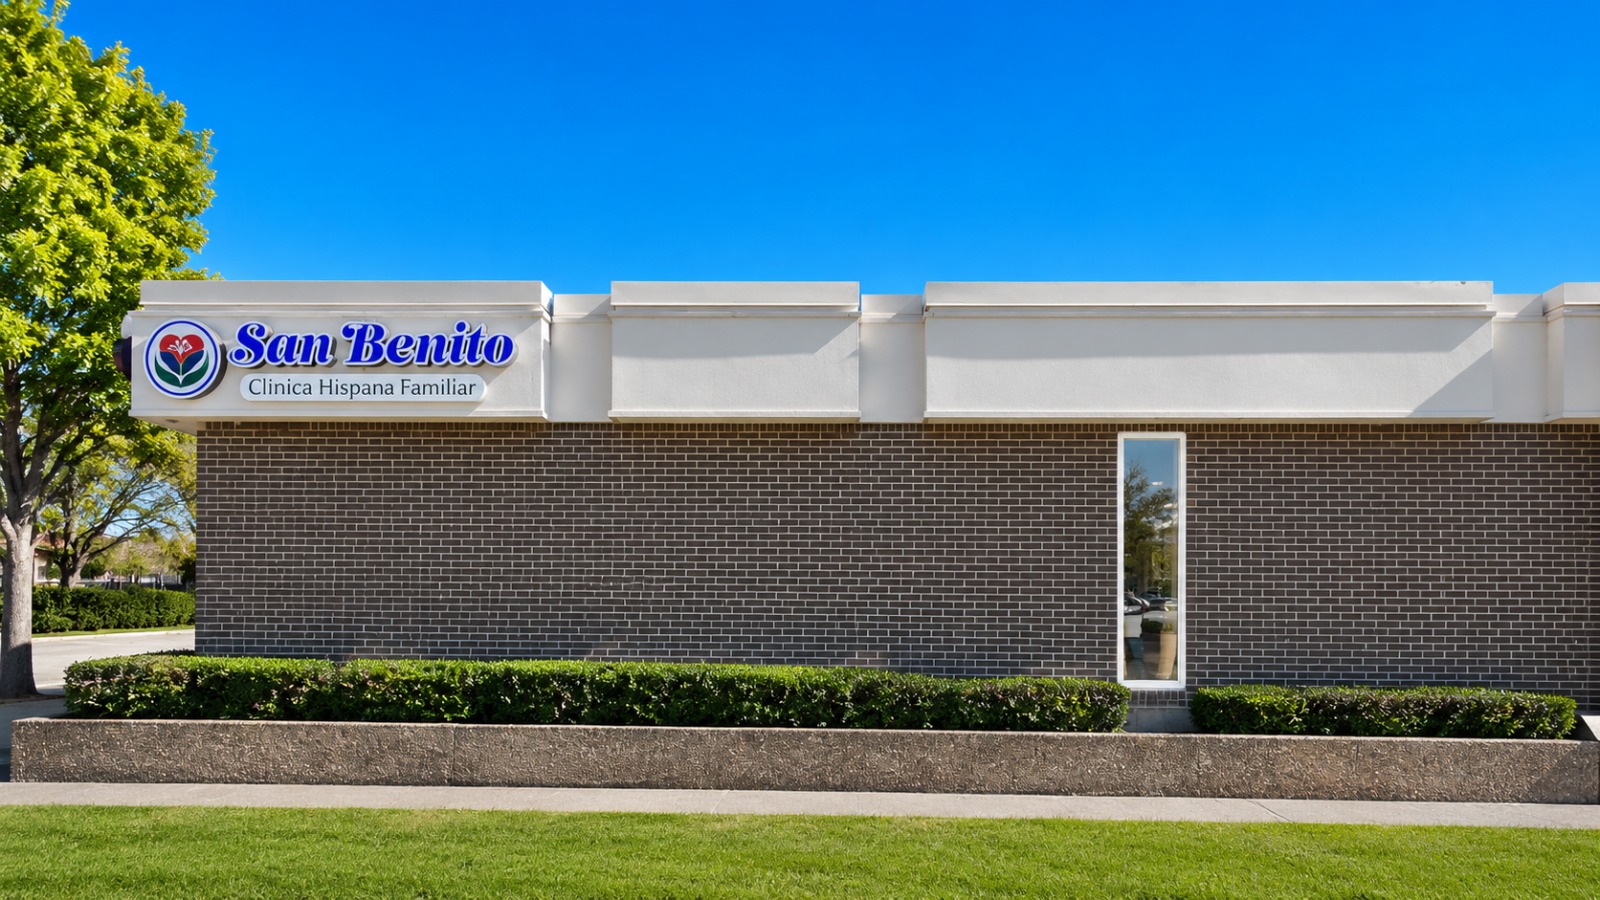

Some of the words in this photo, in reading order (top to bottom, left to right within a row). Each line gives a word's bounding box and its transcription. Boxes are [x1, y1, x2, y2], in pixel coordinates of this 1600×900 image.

[229, 322, 336, 364] San
[341, 321, 514, 364] Benito
[248, 378, 312, 395] Clinica
[319, 378, 394, 400] Hispana
[401, 377, 477, 395] Familiar
